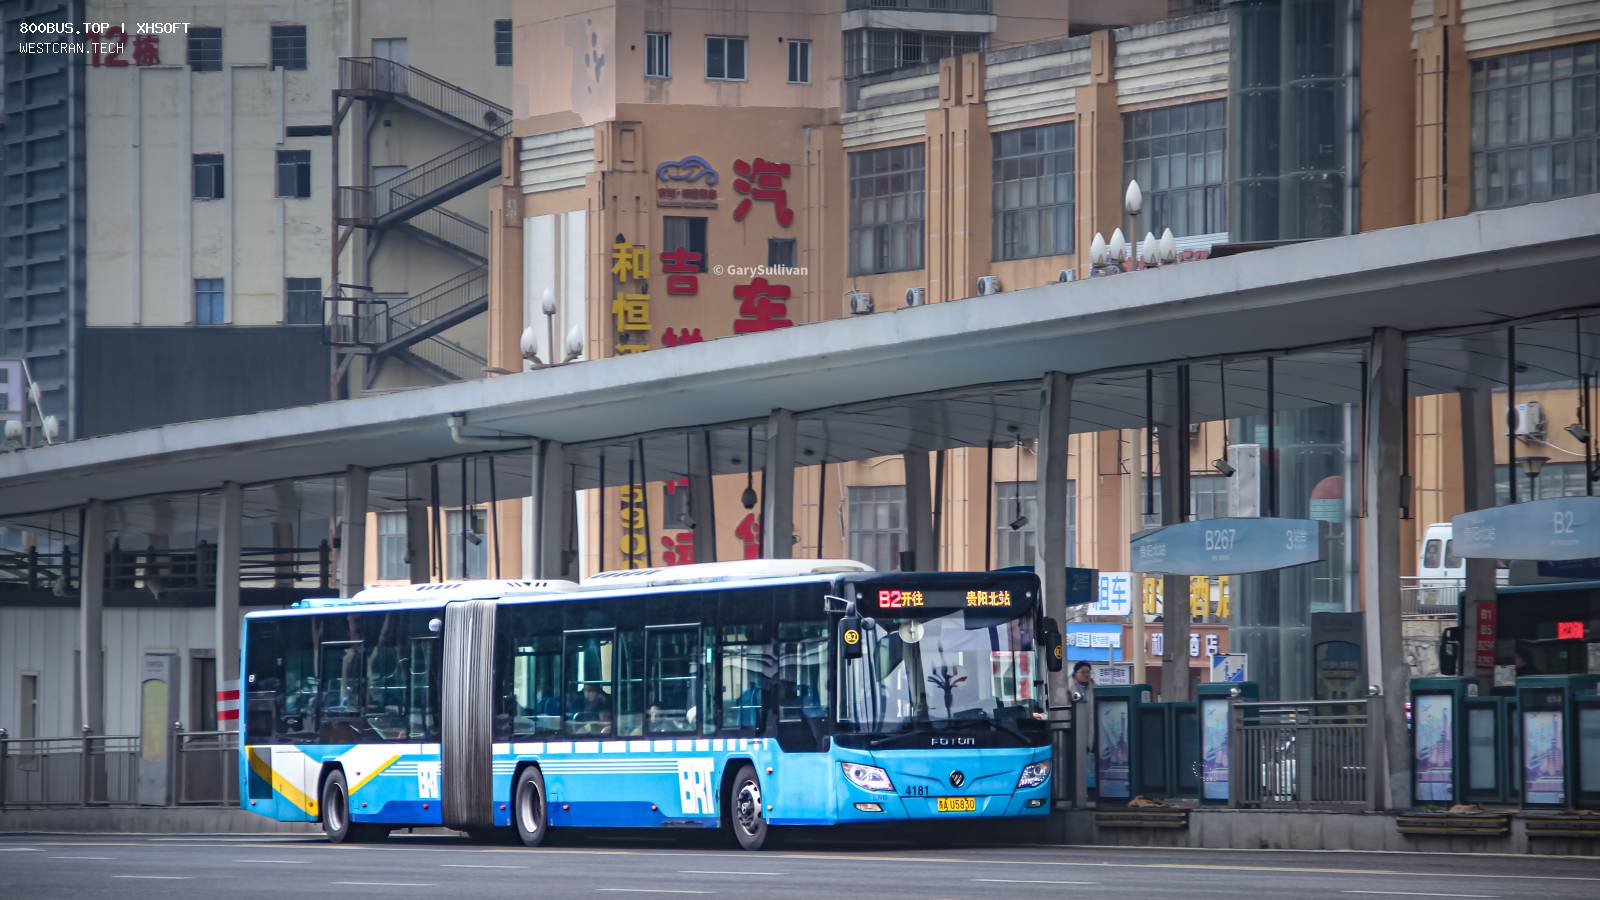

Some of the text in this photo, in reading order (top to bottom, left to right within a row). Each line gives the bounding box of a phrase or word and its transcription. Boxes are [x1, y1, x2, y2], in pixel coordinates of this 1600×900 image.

[1553, 511, 1574, 534] B2
[1205, 529, 1236, 551] B267
[966, 590, 1011, 607] 贵阳北站
[417, 763, 438, 799] BRT
[679, 758, 715, 814] BRT
[906, 785, 929, 796] 4181
